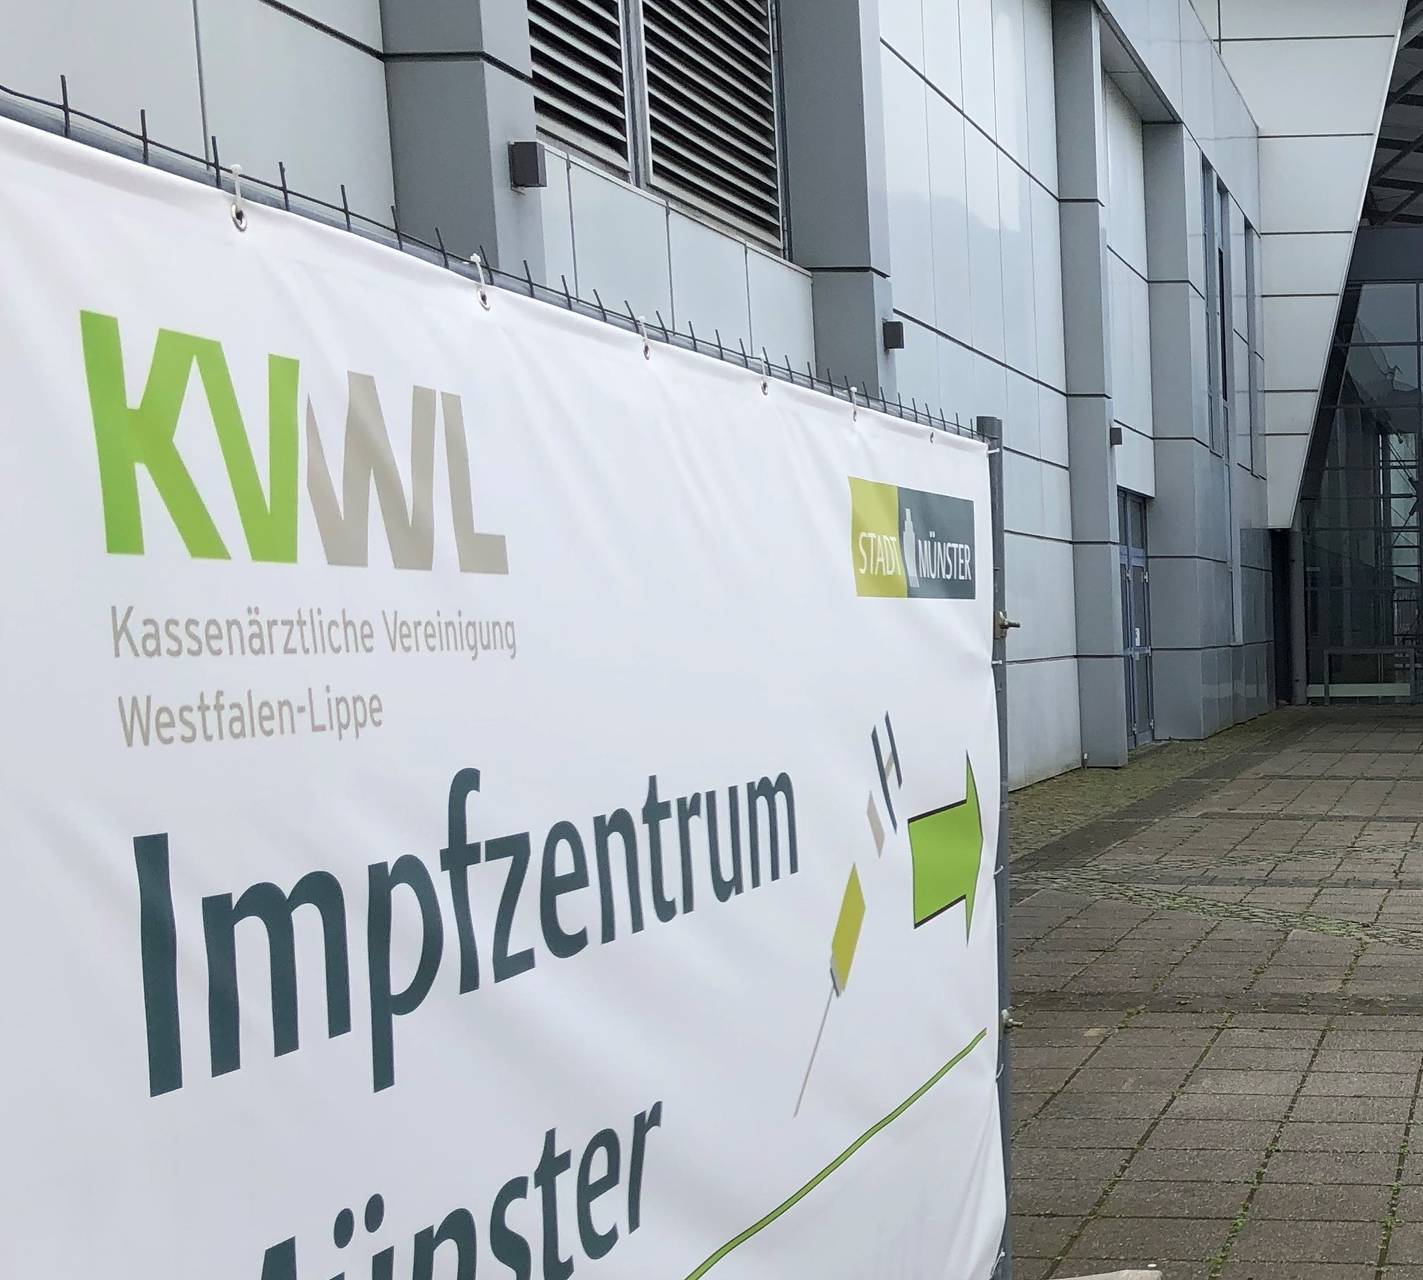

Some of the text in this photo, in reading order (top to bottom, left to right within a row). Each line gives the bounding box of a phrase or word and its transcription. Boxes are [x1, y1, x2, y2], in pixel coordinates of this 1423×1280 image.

[80, 309, 509, 574] KVWL
[858, 531, 972, 581] STADT MÜNSTER
[110, 605, 517, 660] Kassenärztliche Vereinigung
[117, 684, 384, 748] Westfalen-Lippe
[133, 768, 799, 1097] Impfzentrum
